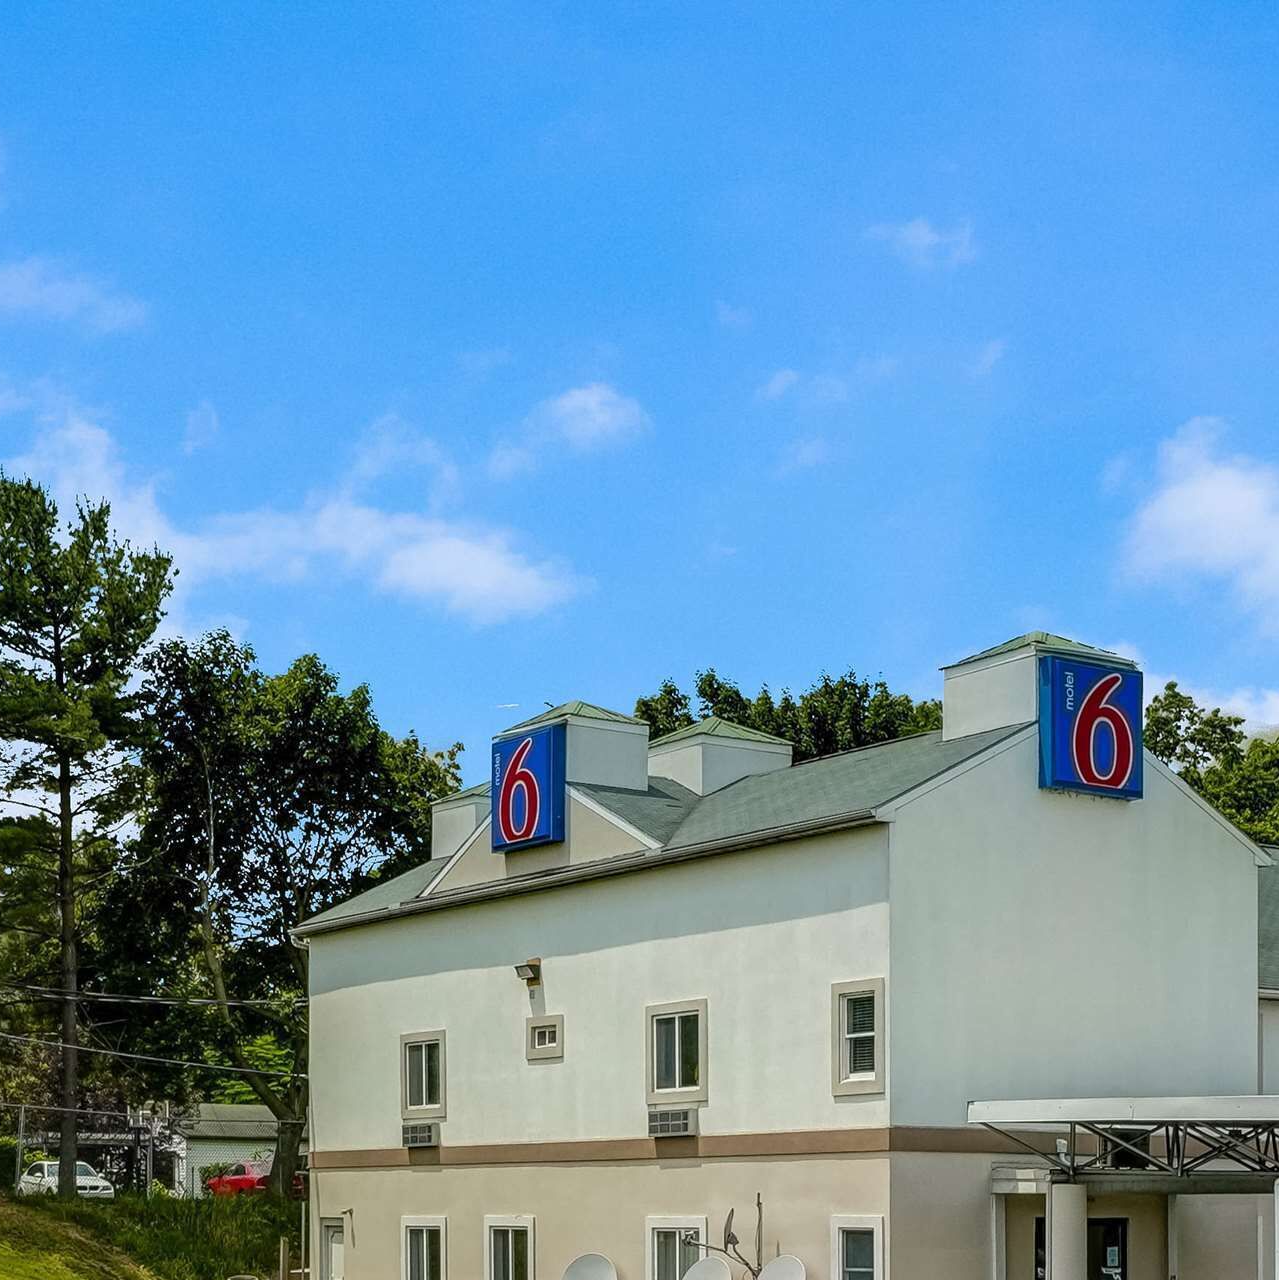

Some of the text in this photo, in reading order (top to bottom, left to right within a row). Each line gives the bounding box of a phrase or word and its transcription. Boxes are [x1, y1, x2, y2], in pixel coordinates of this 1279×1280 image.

[1064, 672, 1133, 788] motel 6
[500, 738, 539, 842] 6
